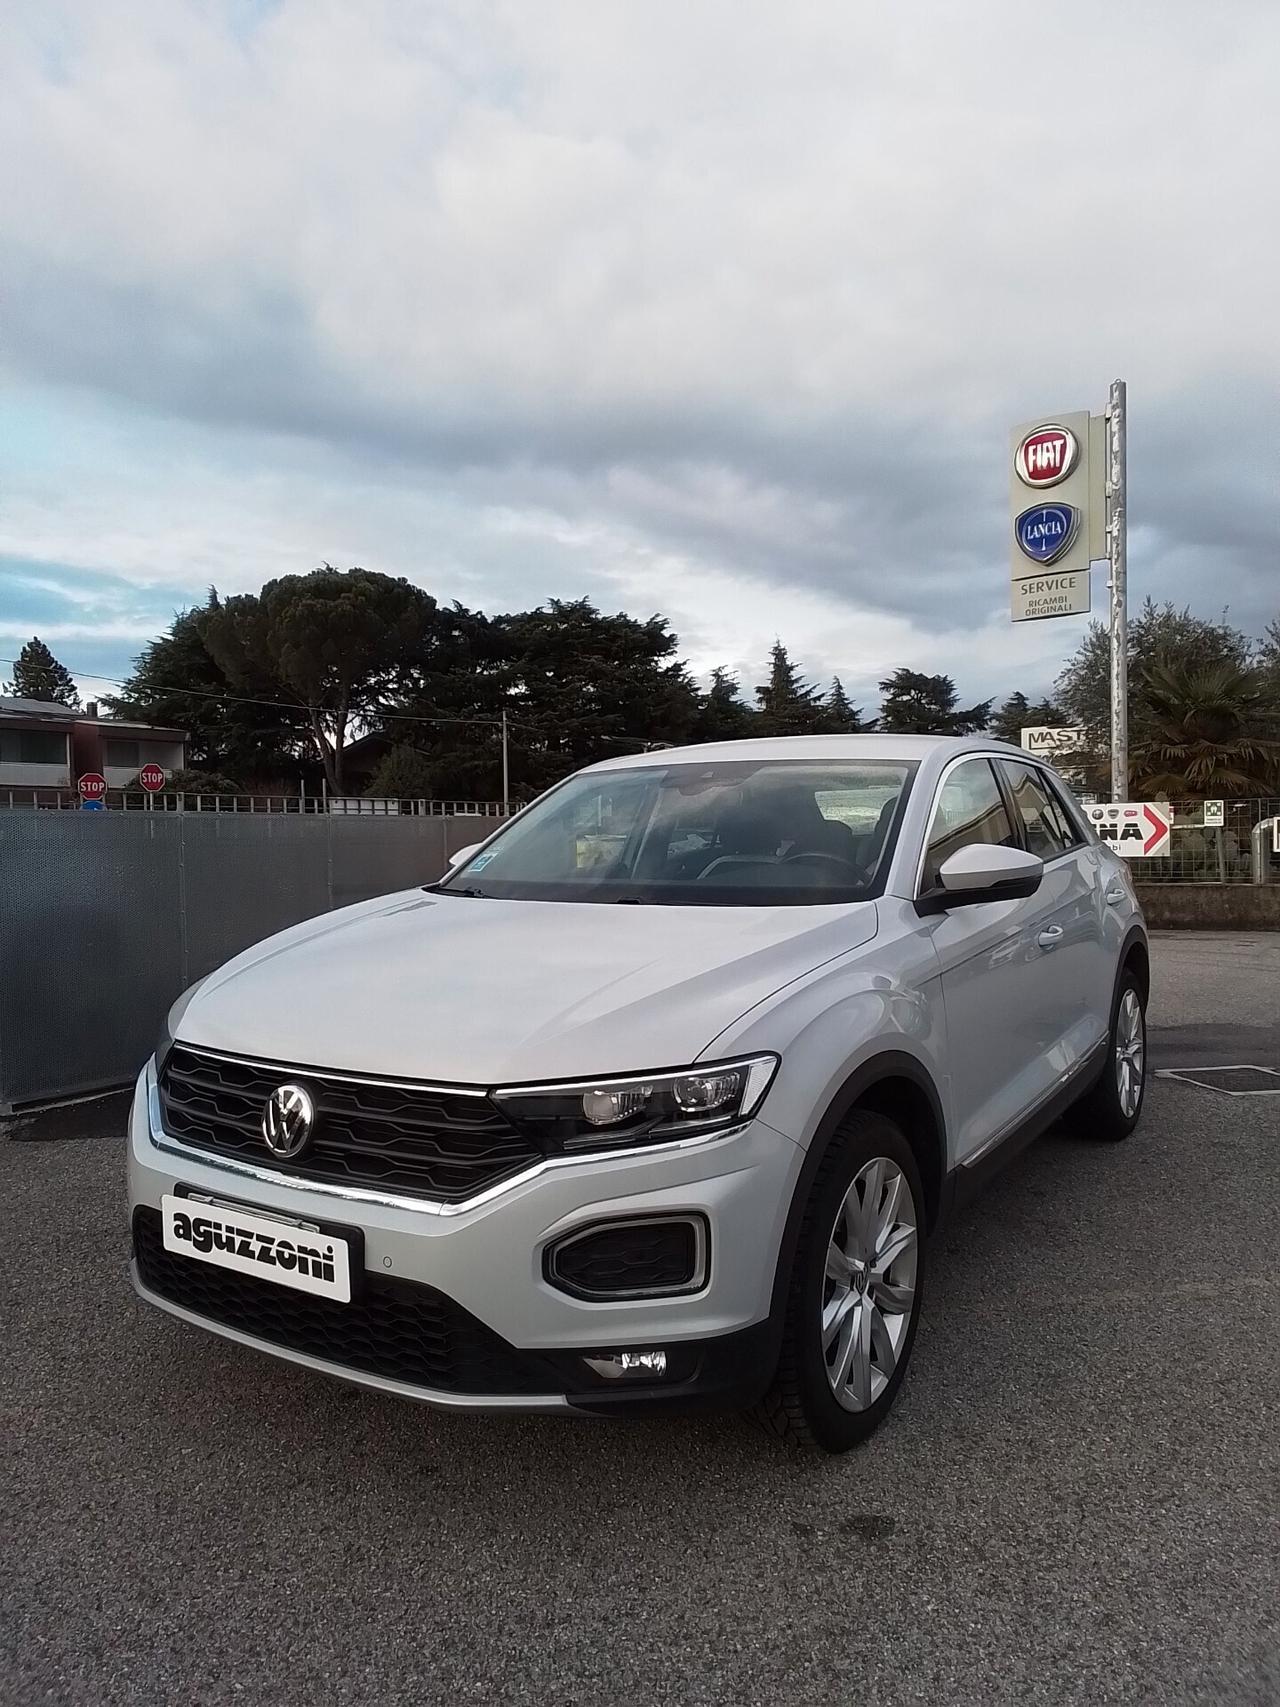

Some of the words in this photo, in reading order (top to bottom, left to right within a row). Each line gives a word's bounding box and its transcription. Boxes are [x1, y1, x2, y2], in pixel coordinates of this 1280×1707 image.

[1028, 440, 1065, 473] FIAT
[1027, 521, 1062, 540] LANCIA
[1021, 577, 1077, 595] SERVICE
[1025, 603, 1072, 617] ORIGINALI
[1029, 595, 1068, 608] RICAMBI
[142, 772, 163, 783] STOP
[80, 782, 105, 792] STOP
[1093, 823, 1144, 841] NA
[173, 1212, 336, 1284] aguzzoni
